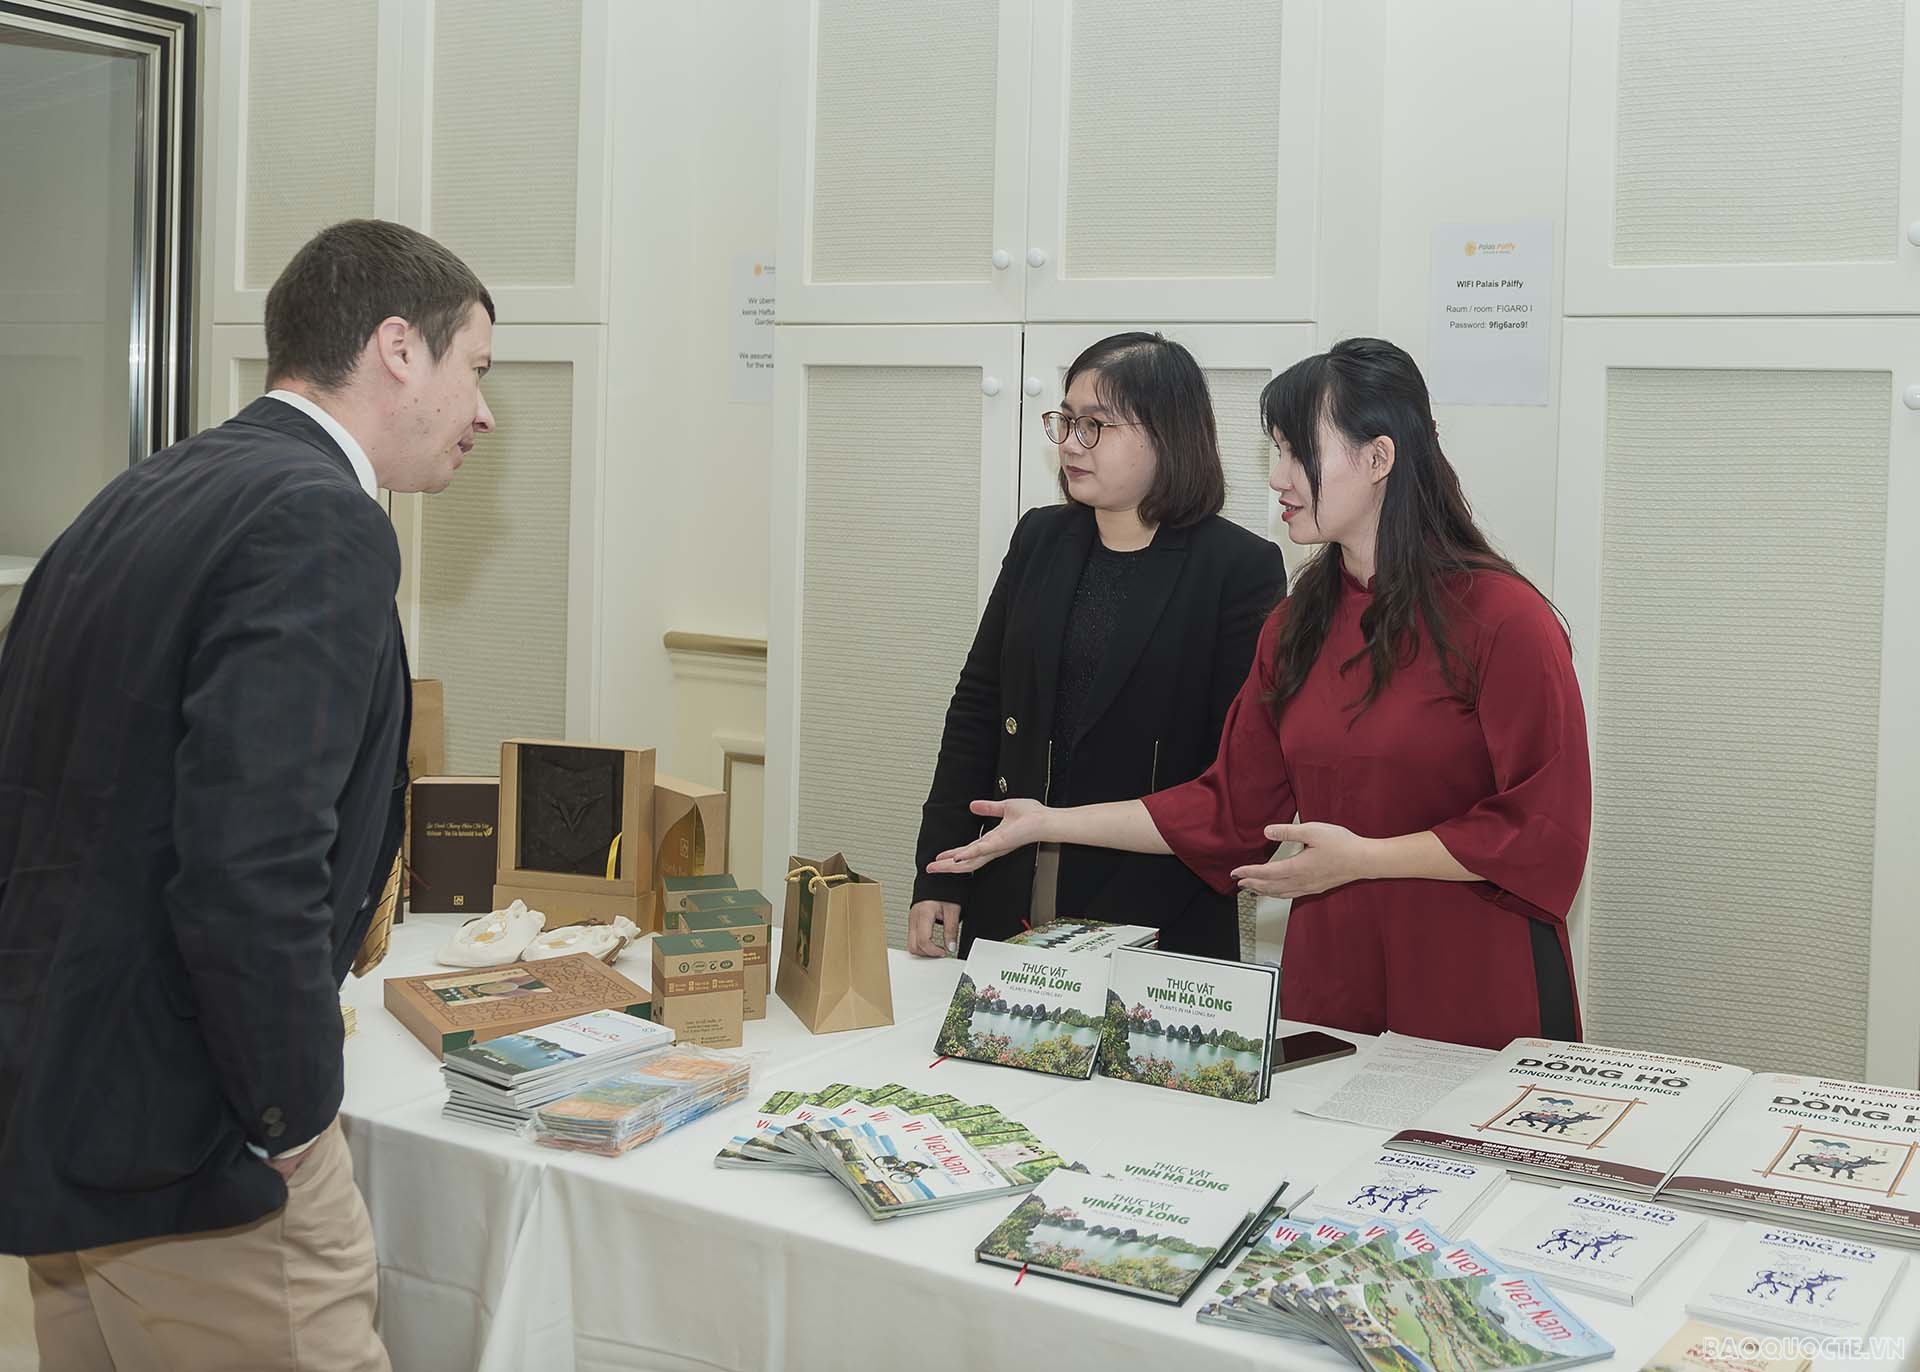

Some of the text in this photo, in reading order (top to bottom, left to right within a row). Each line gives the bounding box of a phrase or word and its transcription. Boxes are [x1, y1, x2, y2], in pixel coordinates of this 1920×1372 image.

[1456, 280, 1474, 288] WIFI
[1476, 280, 1500, 288] Palais
[1446, 304, 1468, 313] Raum
[1473, 304, 1494, 313] room:
[1496, 304, 1529, 313] FIGARO
[1449, 320, 1487, 329] Password:
[1000, 970, 1082, 992] VỊNH HẠ LONG
[1147, 986, 1233, 1012] VỊNH HẠ LONG
[1638, 1065, 1677, 1074] GIAN
[1509, 1068, 1681, 1096] DONGHO'S FOLK PAINTINGS
[756, 1119, 772, 1129] Vi
[797, 1111, 813, 1121] Vi
[869, 1111, 891, 1121] Vi
[1768, 1107, 1920, 1133] DONGHO'S FOLK PAIN
[902, 1121, 926, 1132] Vi
[922, 1134, 971, 1176] Viet Nam
[1161, 1172, 1184, 1184] HẠ
[1187, 1177, 1230, 1192] LONG
[1120, 1205, 1143, 1217] HẠ
[1145, 1210, 1191, 1225] LONG
[1275, 1226, 1301, 1242] Vie
[1317, 1224, 1347, 1241] Vie
[1365, 1226, 1390, 1240] Vi
[1404, 1228, 1436, 1253] Vie
[1446, 1248, 1489, 1277] Viet
[1501, 1279, 1572, 1340] Viet Nam
